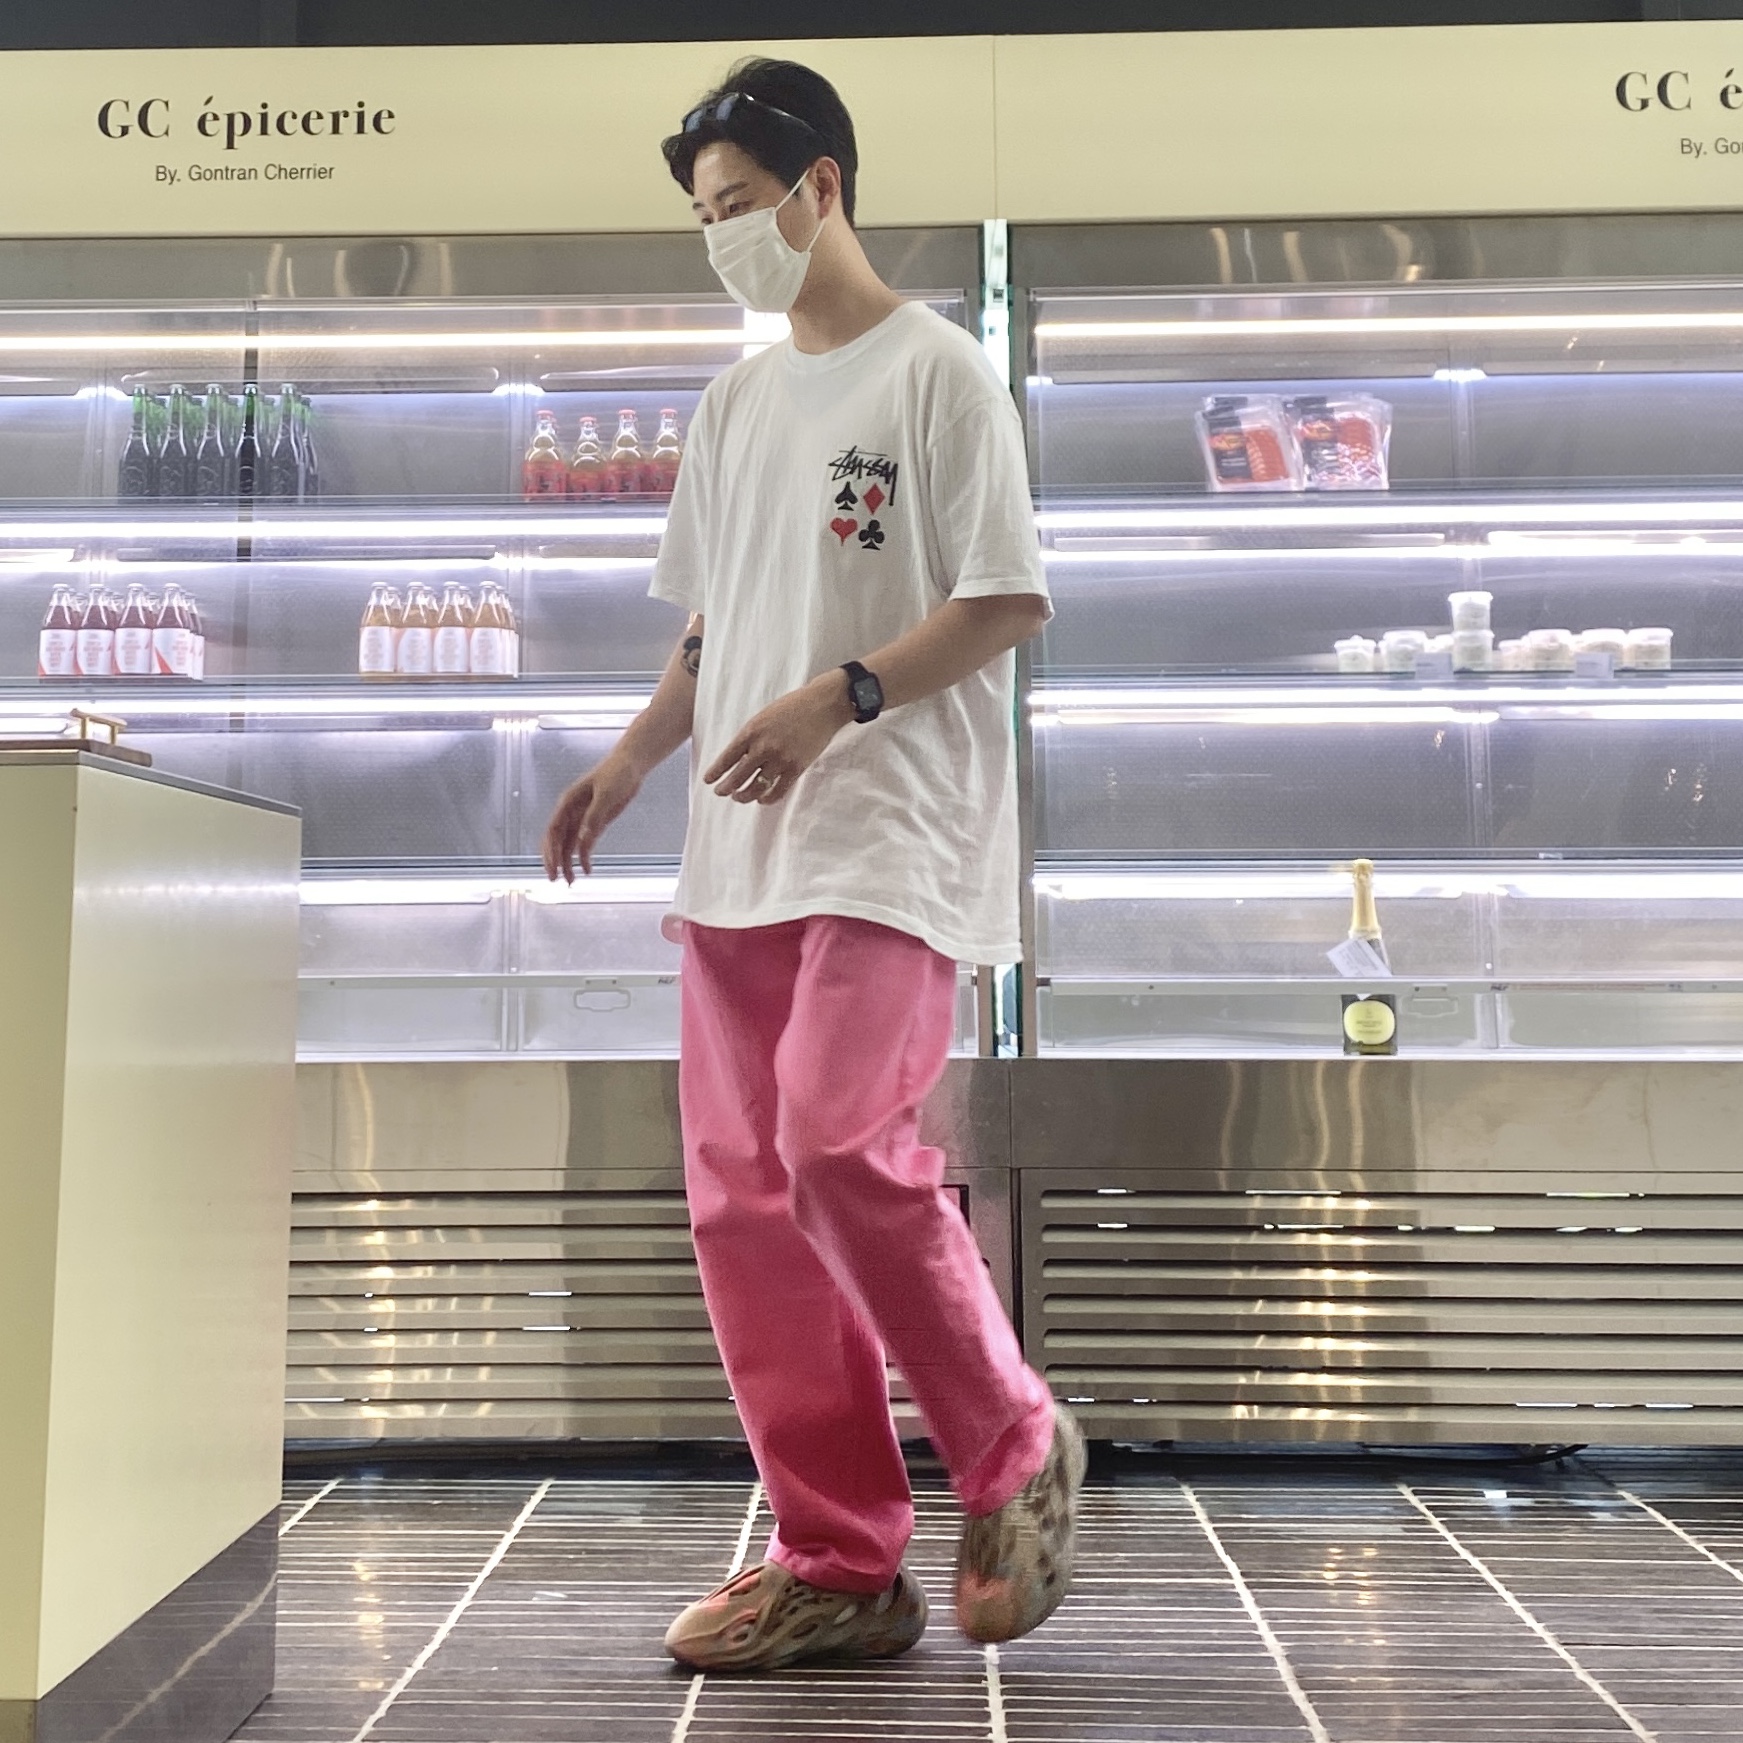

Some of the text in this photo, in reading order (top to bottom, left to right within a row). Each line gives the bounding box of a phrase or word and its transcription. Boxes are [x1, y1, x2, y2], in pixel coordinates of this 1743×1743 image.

[1614, 70, 1692, 112] GC
[97, 95, 396, 150] GC épicerie
[1680, 136, 1743, 159] By. Go
[155, 163, 335, 186] By. Gontran Cherrier
